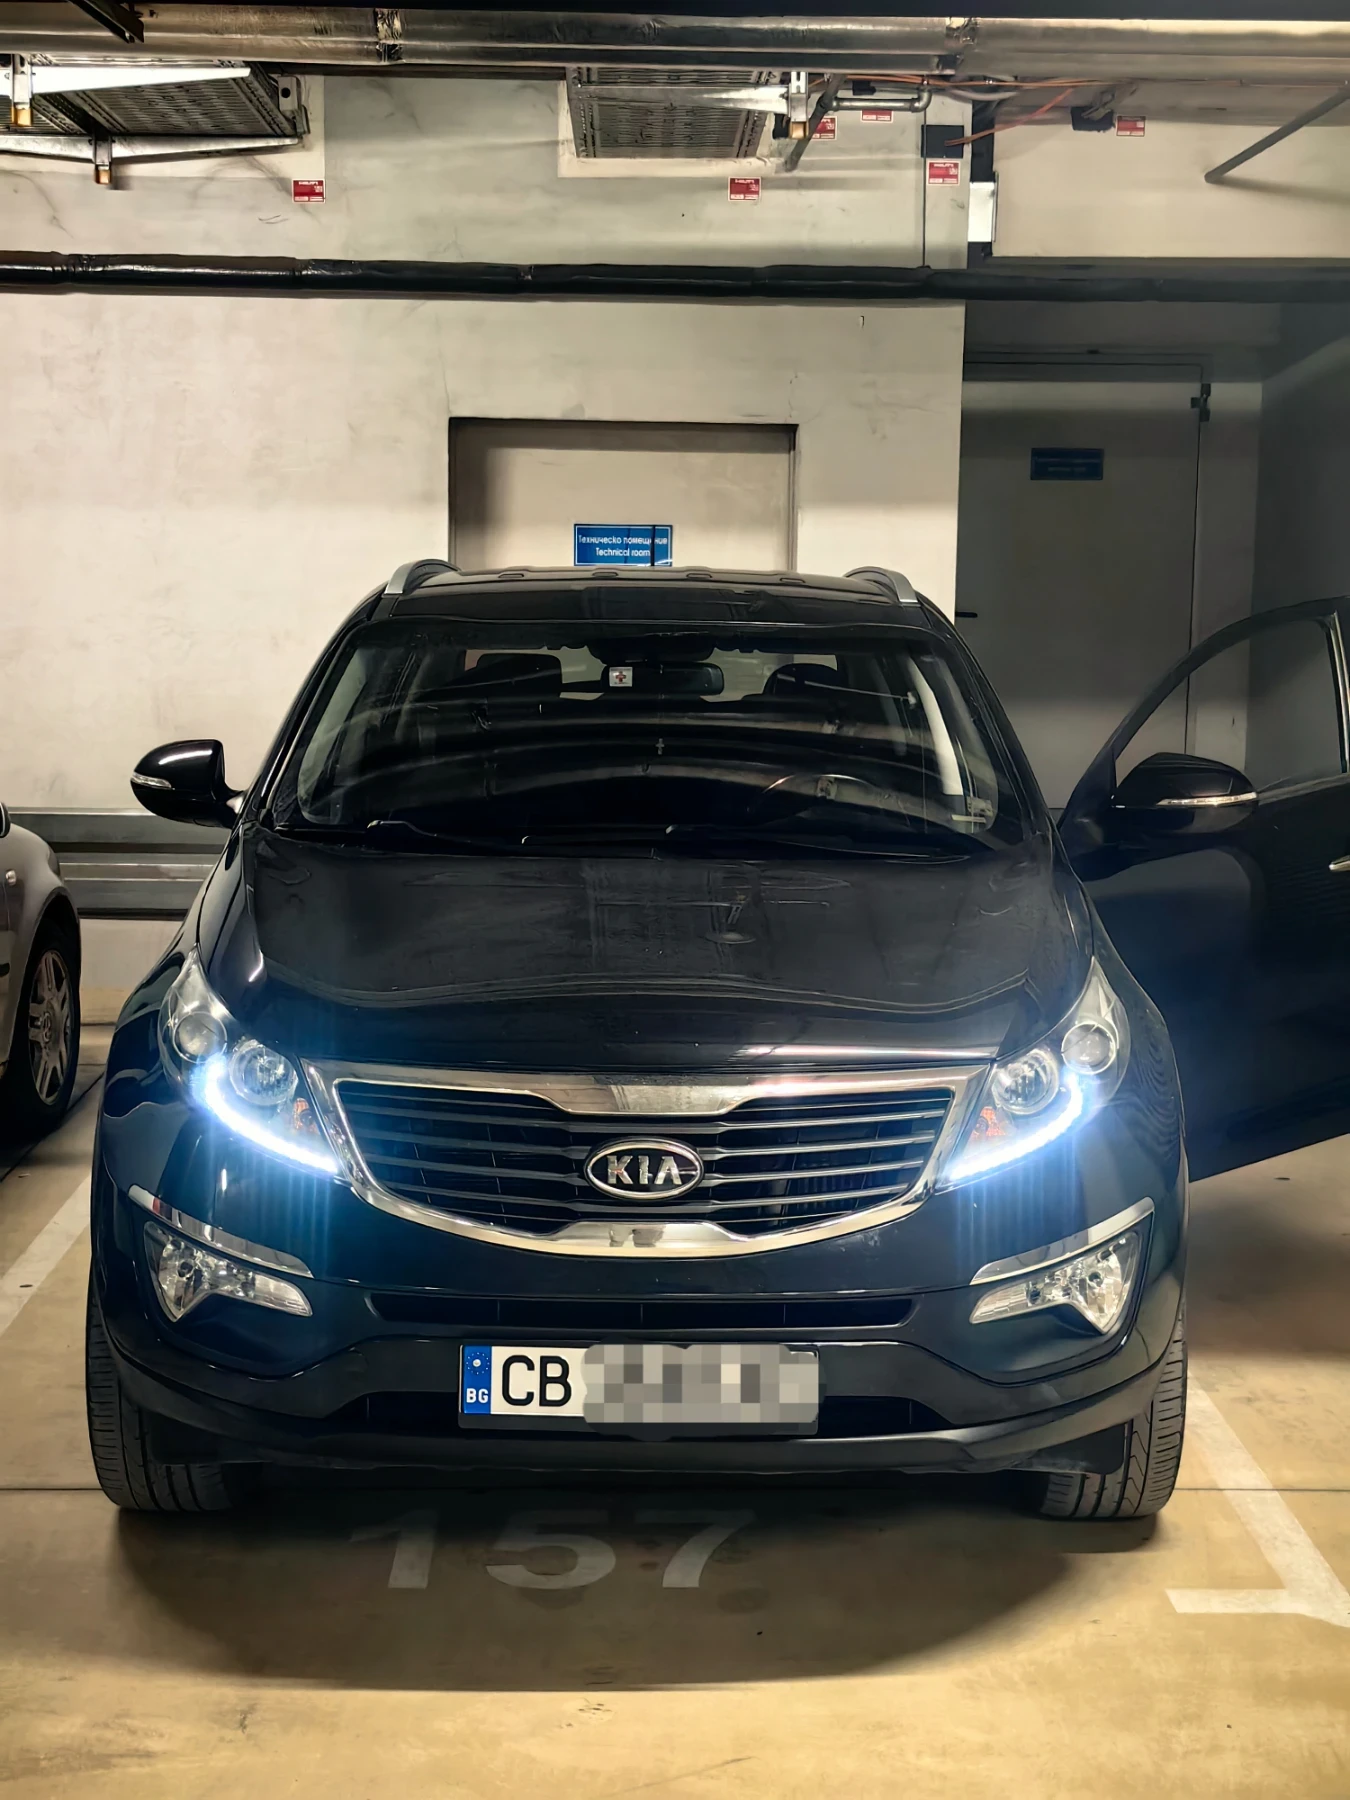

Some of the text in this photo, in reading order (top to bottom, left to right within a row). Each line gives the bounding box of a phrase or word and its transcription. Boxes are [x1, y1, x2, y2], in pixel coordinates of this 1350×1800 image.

[578, 535, 668, 545] Техническо помещние
[595, 547, 651, 557] Technical room
[606, 1155, 682, 1185] KIA
[501, 1354, 572, 1408] CB
[465, 1388, 489, 1404] BG
[349, 1509, 758, 1590] 157
